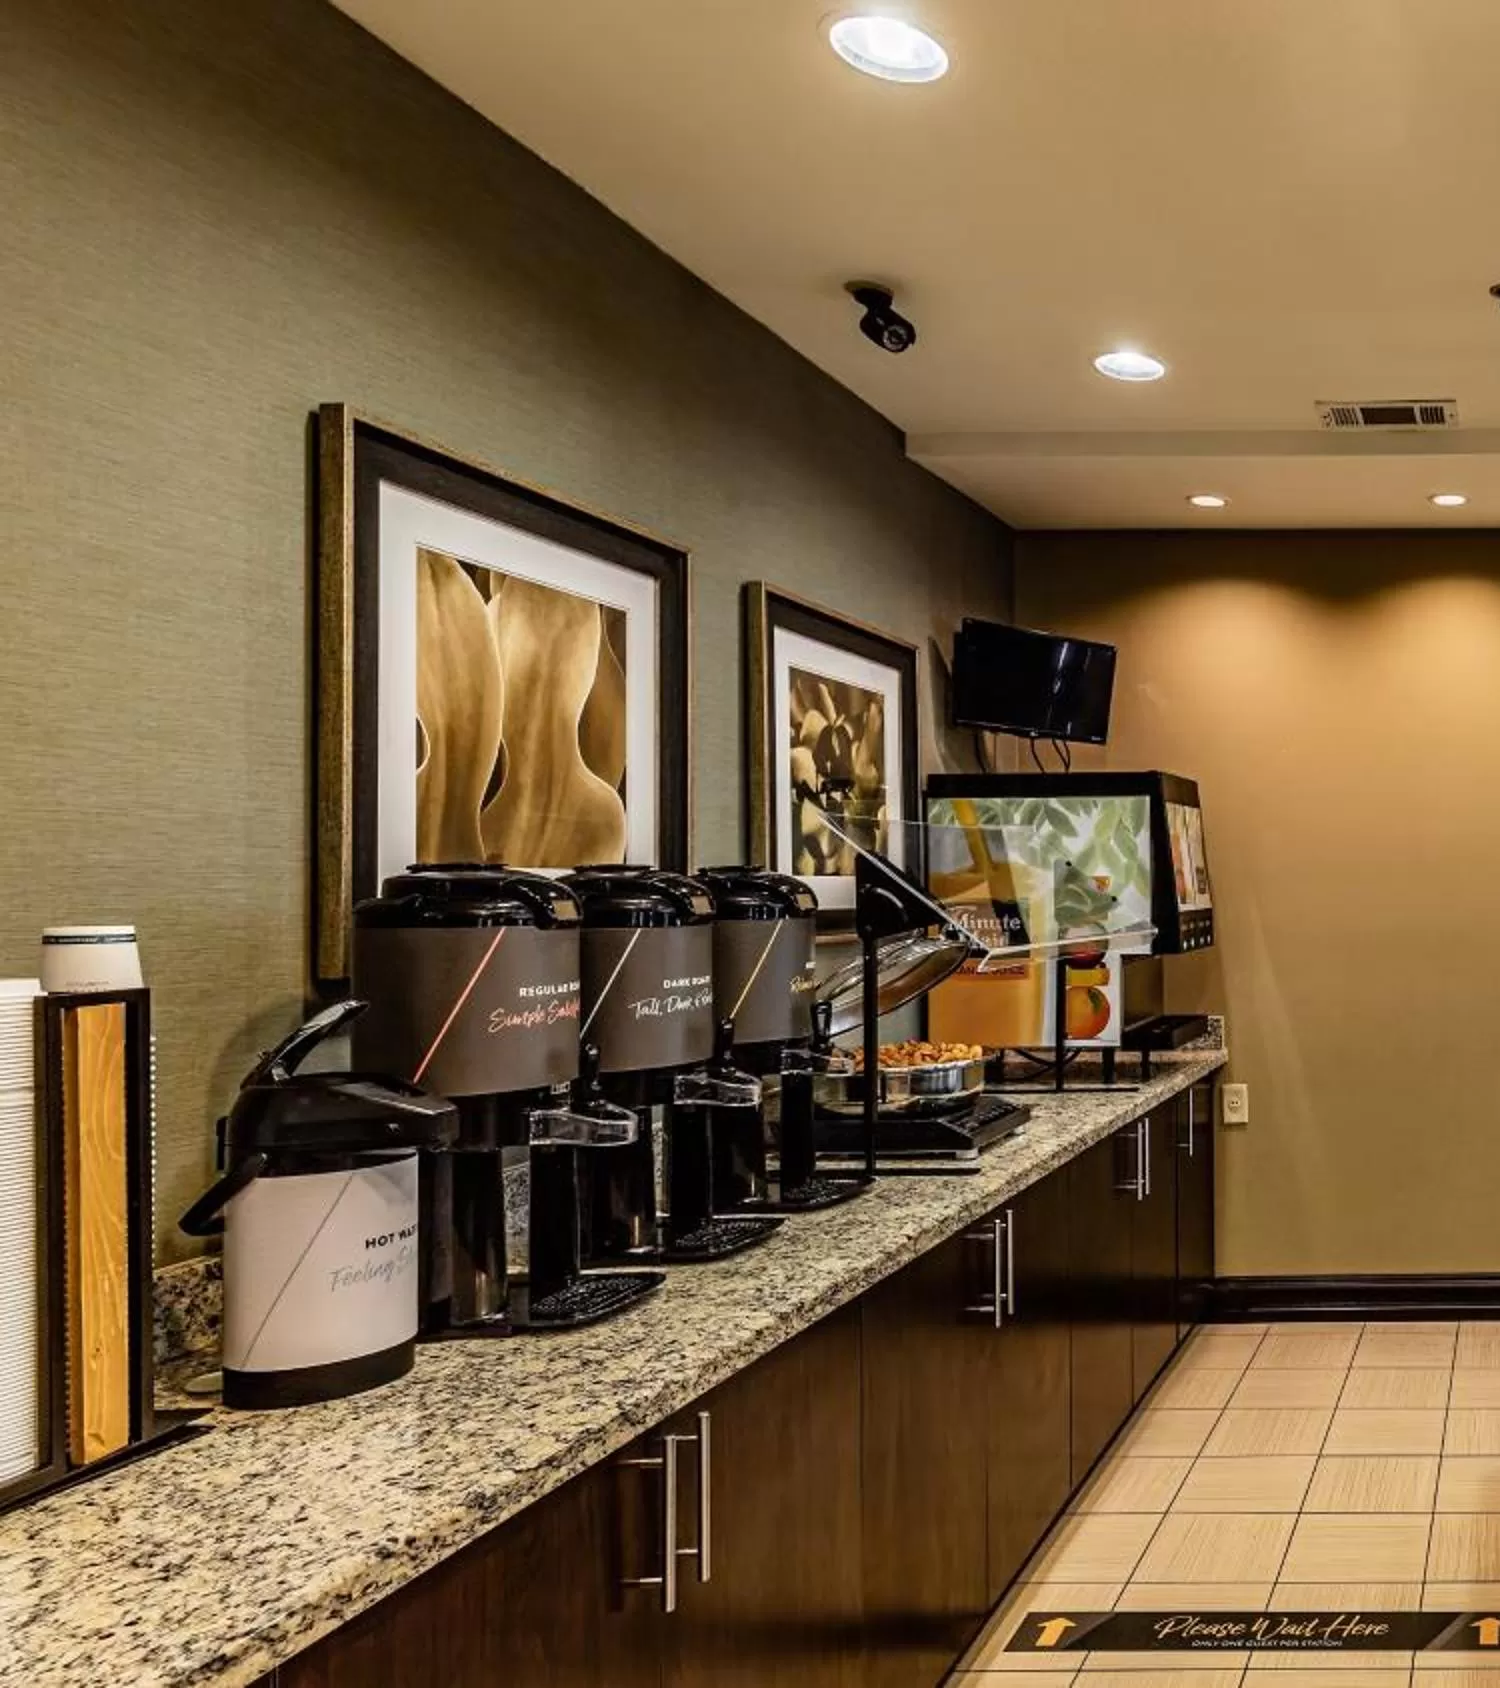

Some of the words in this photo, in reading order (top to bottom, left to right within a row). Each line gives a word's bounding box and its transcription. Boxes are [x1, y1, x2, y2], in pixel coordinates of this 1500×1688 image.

[364, 1232, 395, 1250] HOT
[1154, 1615, 1248, 1639] Please
[1251, 1616, 1319, 1641] Wait
[1318, 1614, 1390, 1640] Here
[1191, 1638, 1219, 1648] ONLY
[1221, 1638, 1243, 1648] ONE
[1279, 1638, 1300, 1648] PER
